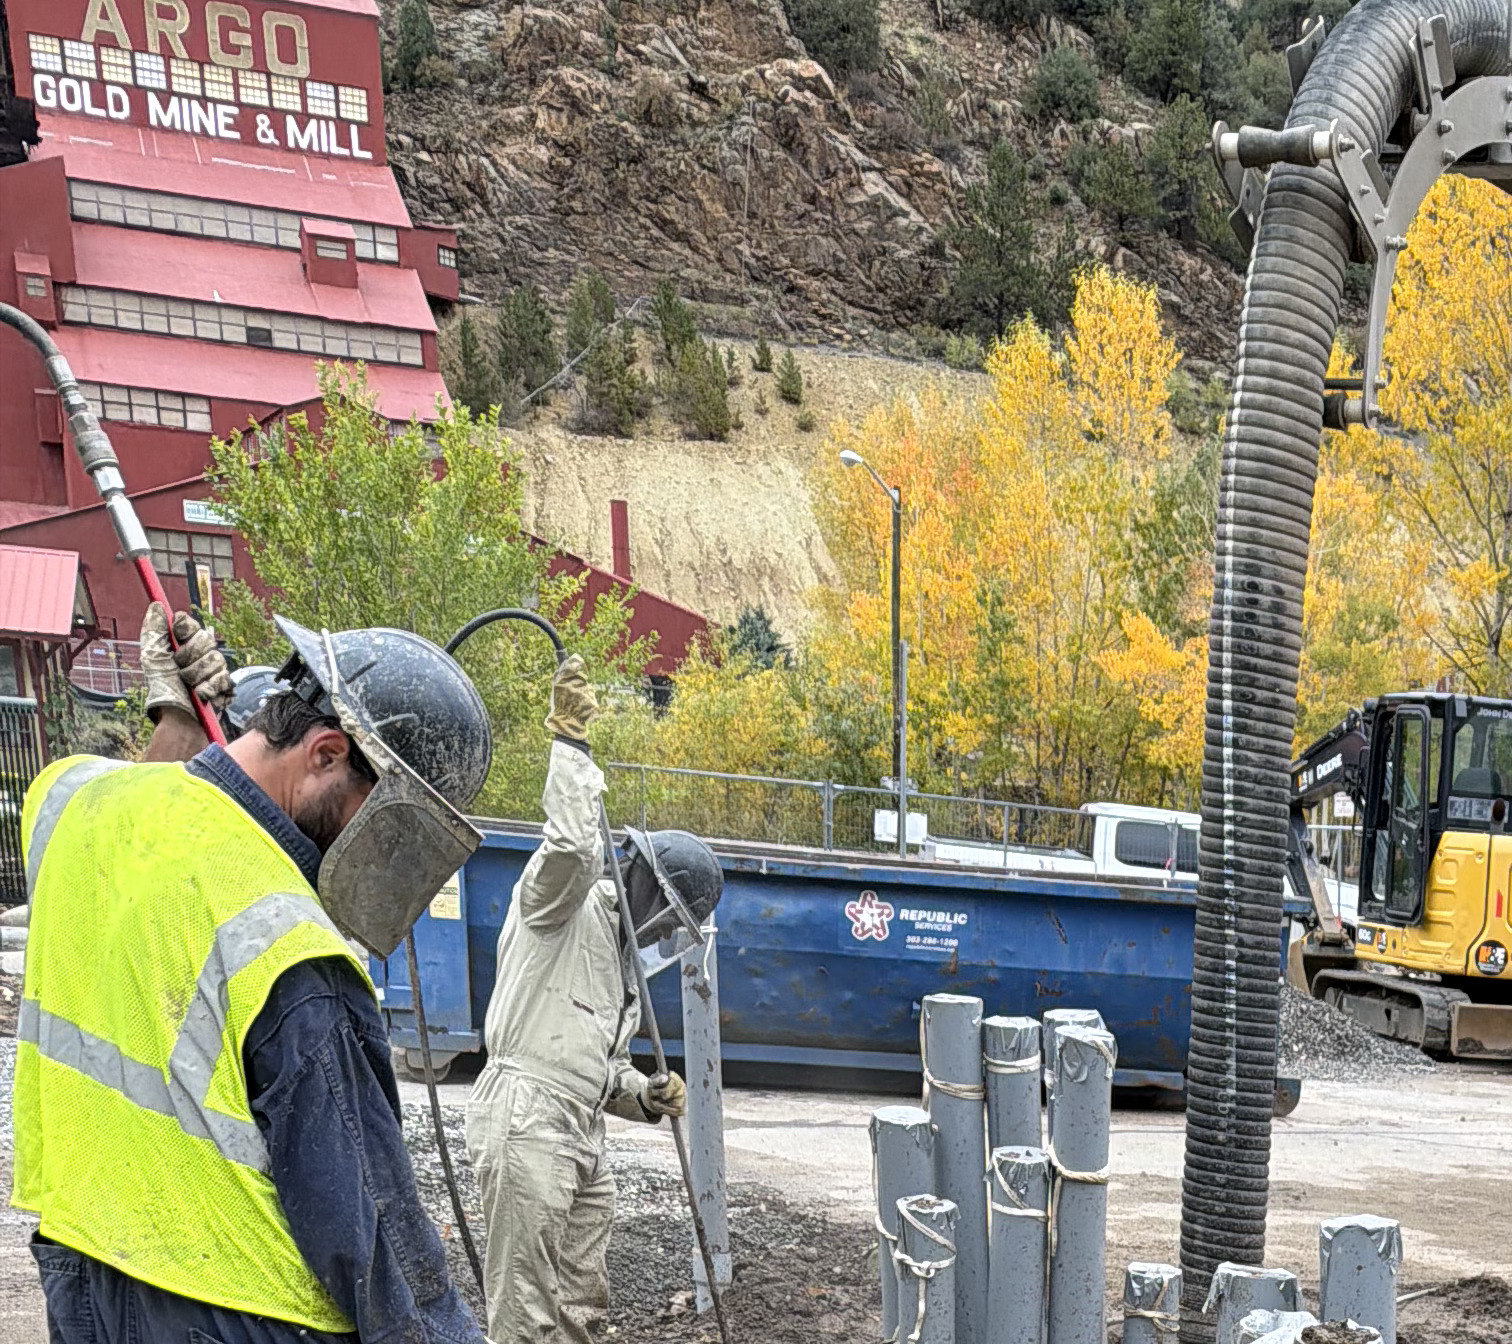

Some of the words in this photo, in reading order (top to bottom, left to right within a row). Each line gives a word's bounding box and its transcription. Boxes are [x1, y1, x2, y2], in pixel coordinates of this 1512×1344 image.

[81, 0, 311, 79] ARGO
[33, 73, 131, 120] GOLD
[147, 91, 241, 140] MINE
[255, 113, 280, 145] &
[285, 115, 373, 160] MILL
[1477, 706, 1502, 718] JOHN
[899, 908, 968, 925] REPUBLIC
[914, 921, 953, 932] SERVICES
